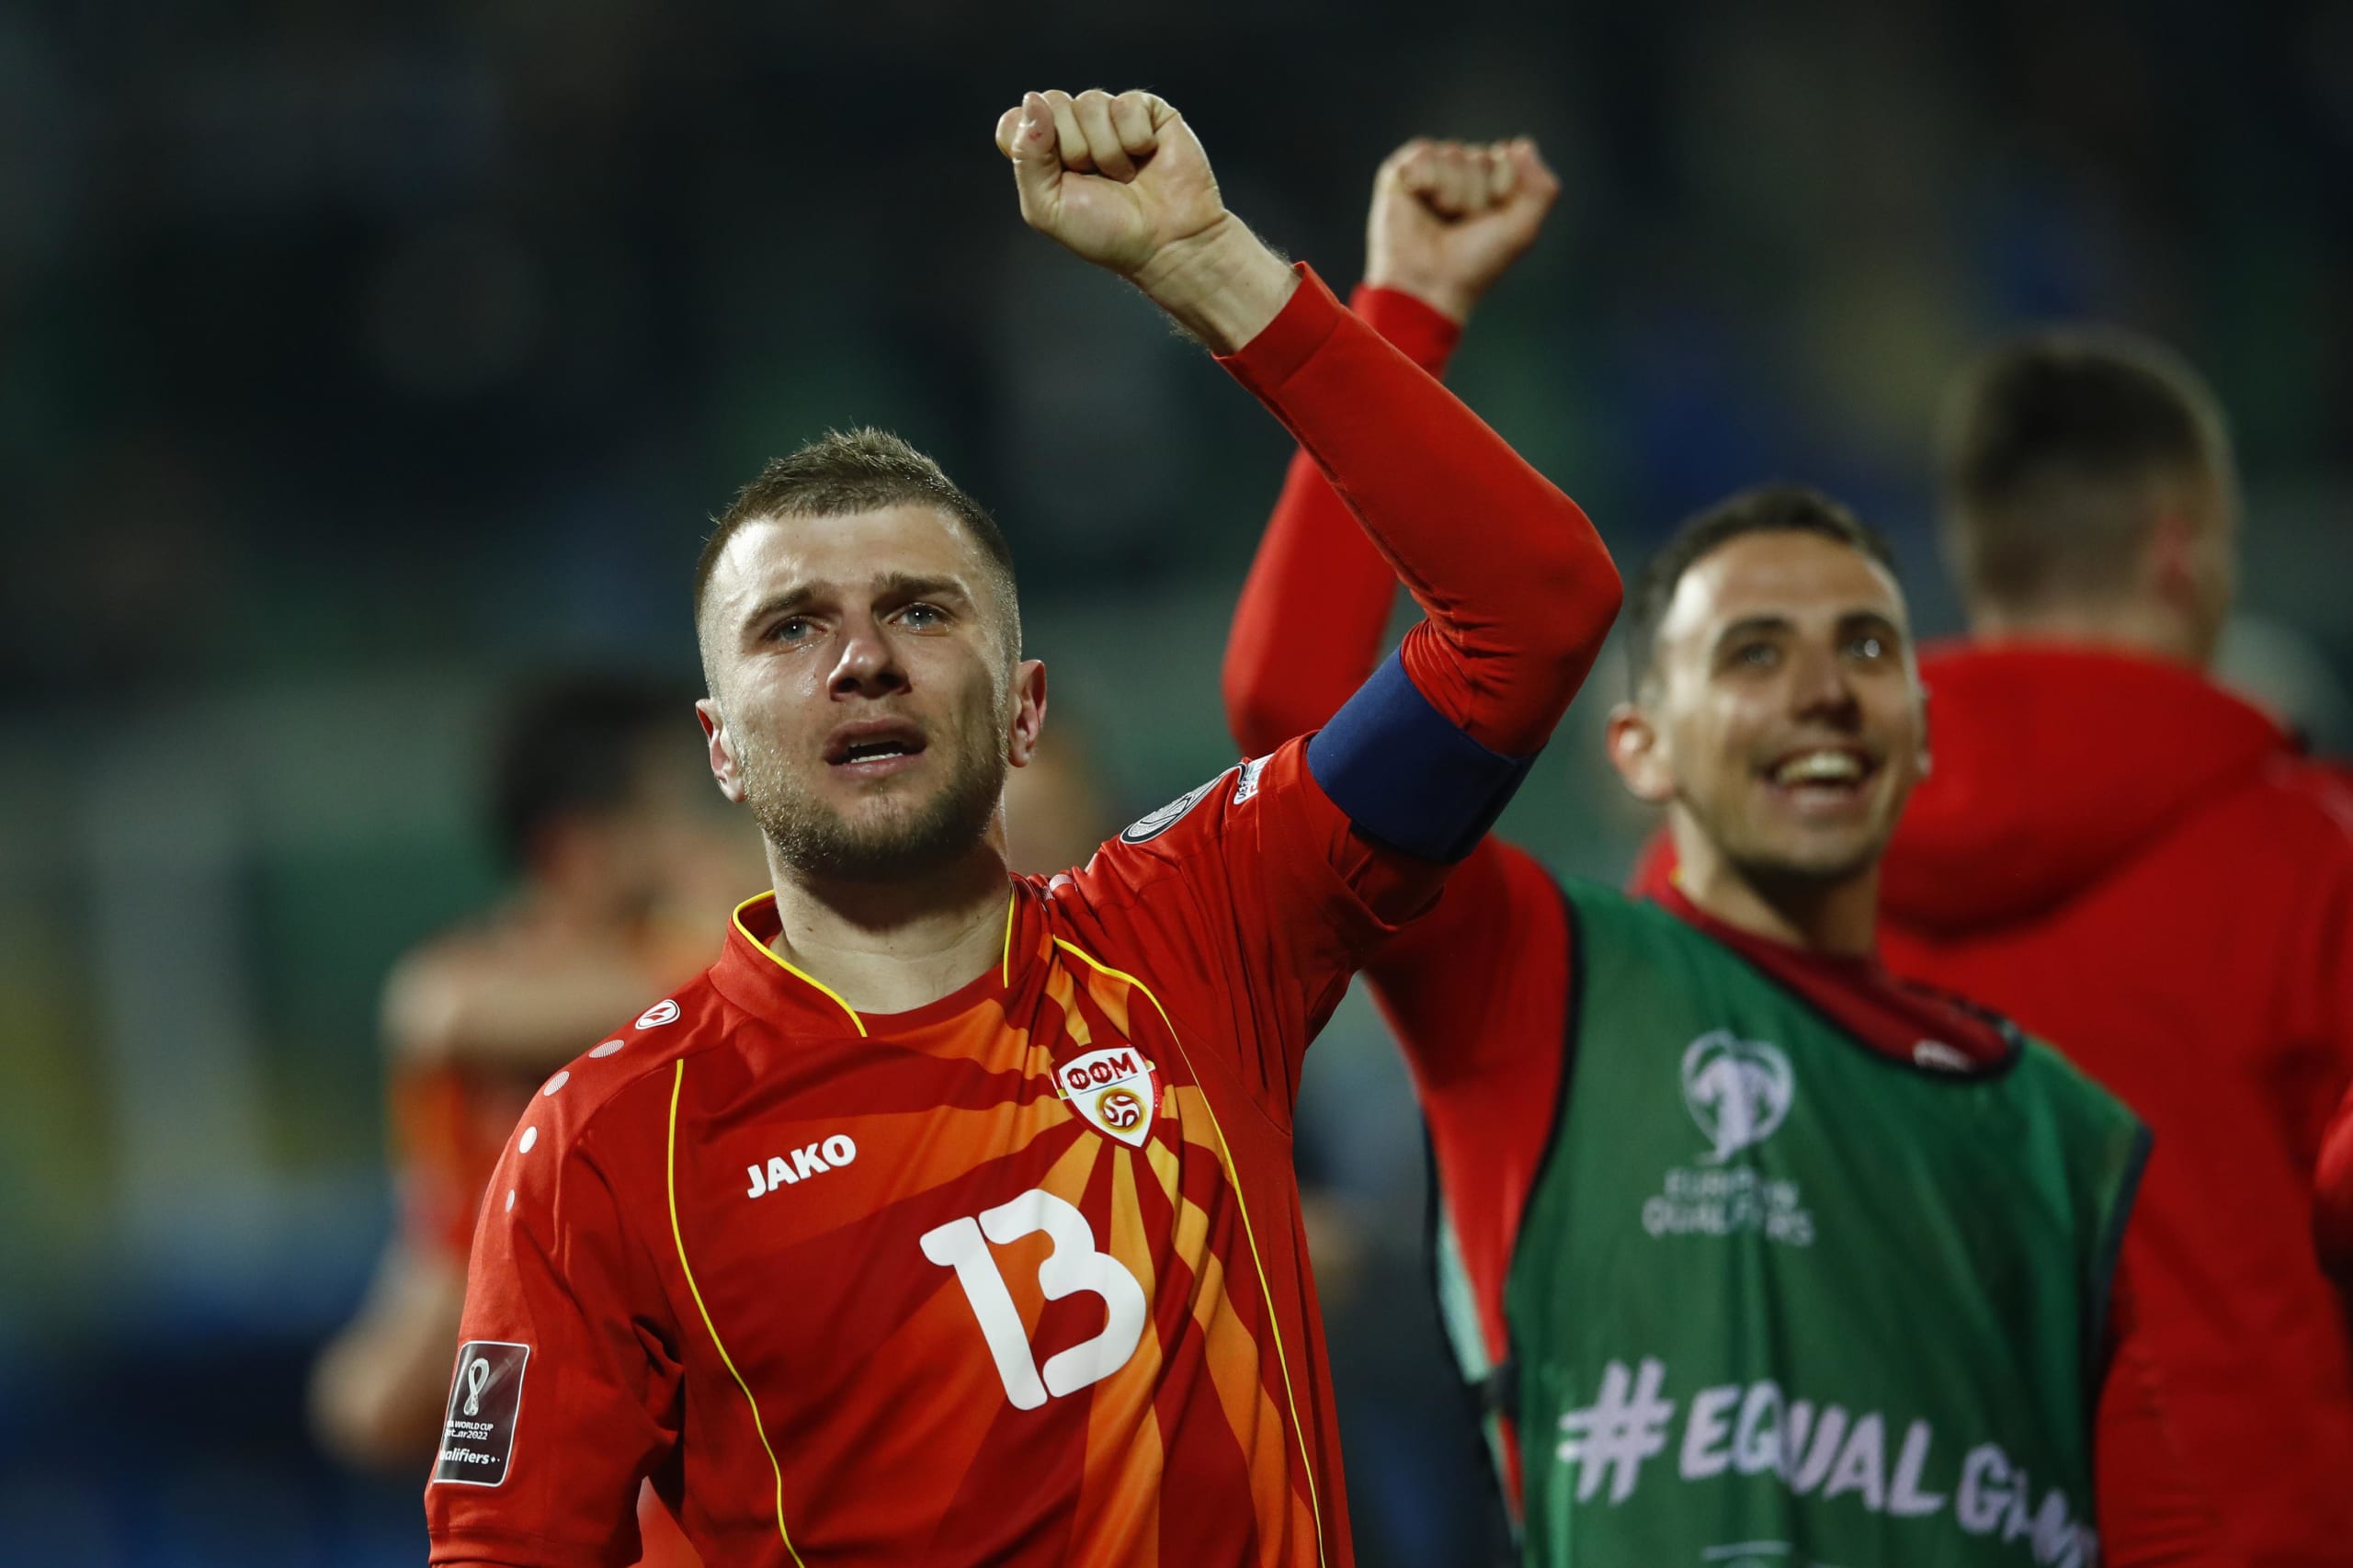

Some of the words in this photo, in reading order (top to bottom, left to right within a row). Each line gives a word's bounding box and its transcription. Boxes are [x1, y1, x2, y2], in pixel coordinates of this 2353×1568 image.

[1067, 1051, 1138, 1091] ФФМ
[746, 1134, 857, 1199] JAKO
[919, 1188, 1146, 1410] 13
[454, 1421, 480, 1430] WORLD
[480, 1423, 494, 1431] CUP
[439, 1448, 490, 1464] ualifiers
